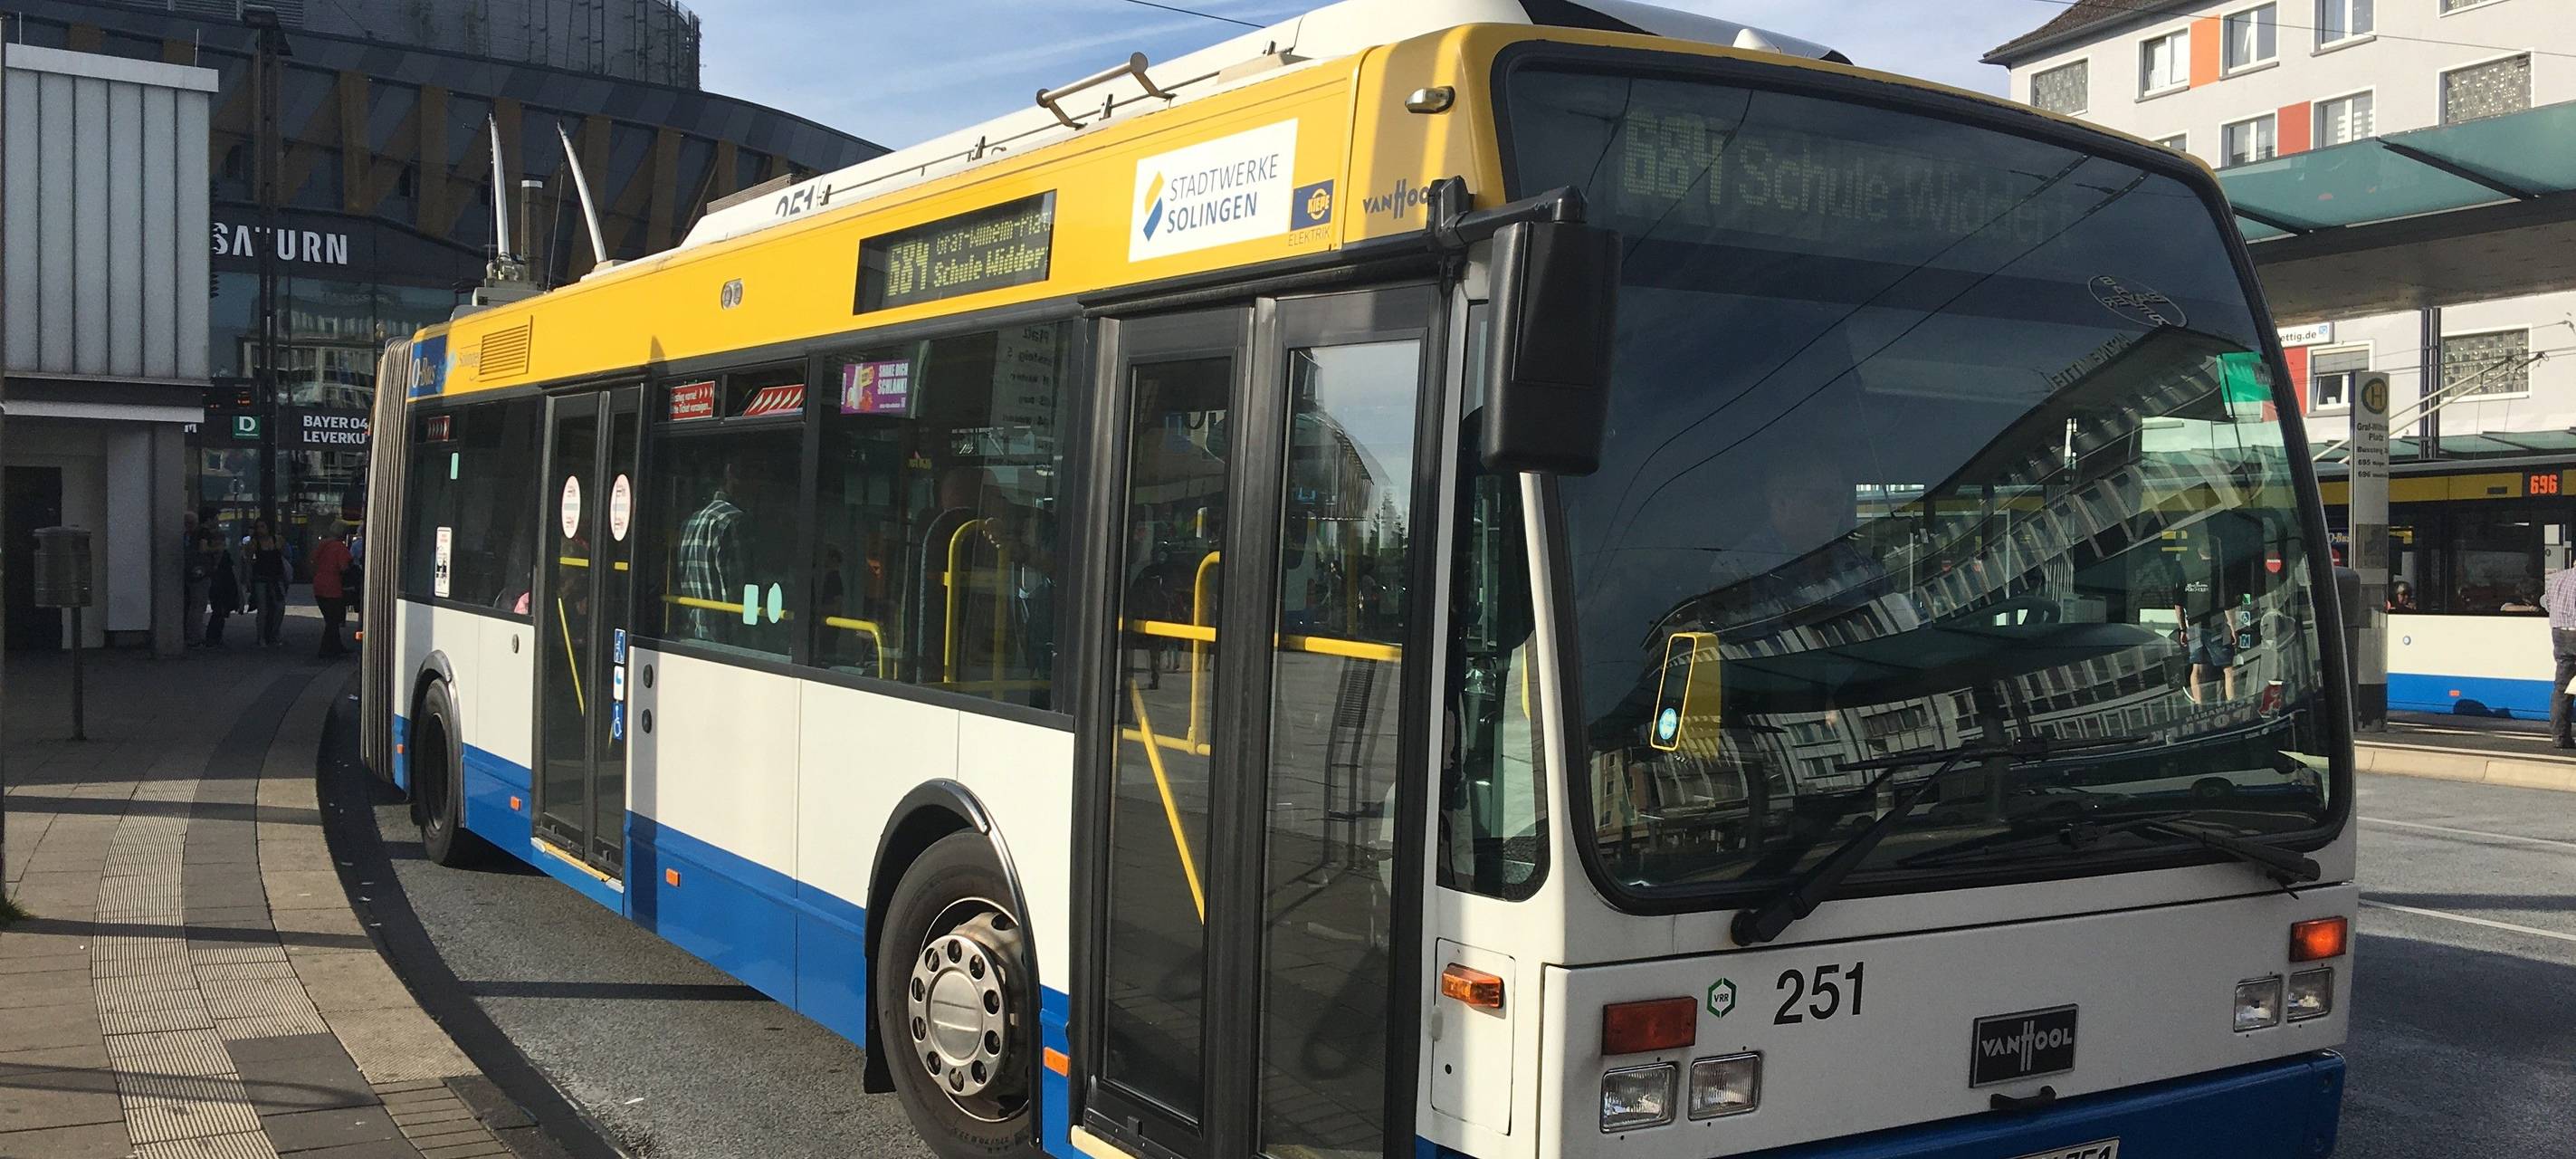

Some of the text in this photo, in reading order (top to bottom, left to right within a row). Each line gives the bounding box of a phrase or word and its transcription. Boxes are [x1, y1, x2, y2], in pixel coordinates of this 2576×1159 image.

[1169, 153, 1279, 202] STADTWERKE
[1626, 110, 1722, 205] 684
[1738, 136, 1889, 221] Schule
[1167, 191, 1257, 234] SOLINGEN
[1307, 194, 1331, 214] KIEPE
[1362, 178, 1429, 219] VANHOO
[211, 222, 348, 265] SAURN
[1288, 225, 1331, 246] ELEKTRIK
[887, 240, 930, 297] 684
[933, 243, 1049, 288] Schule Widder
[239, 416, 256, 431] D
[303, 415, 368, 429] BAYER 04
[2369, 433, 2384, 442] Platz
[2530, 474, 2558, 494] 696
[1713, 992, 1730, 1003] VRR
[1773, 961, 1865, 1026] 251
